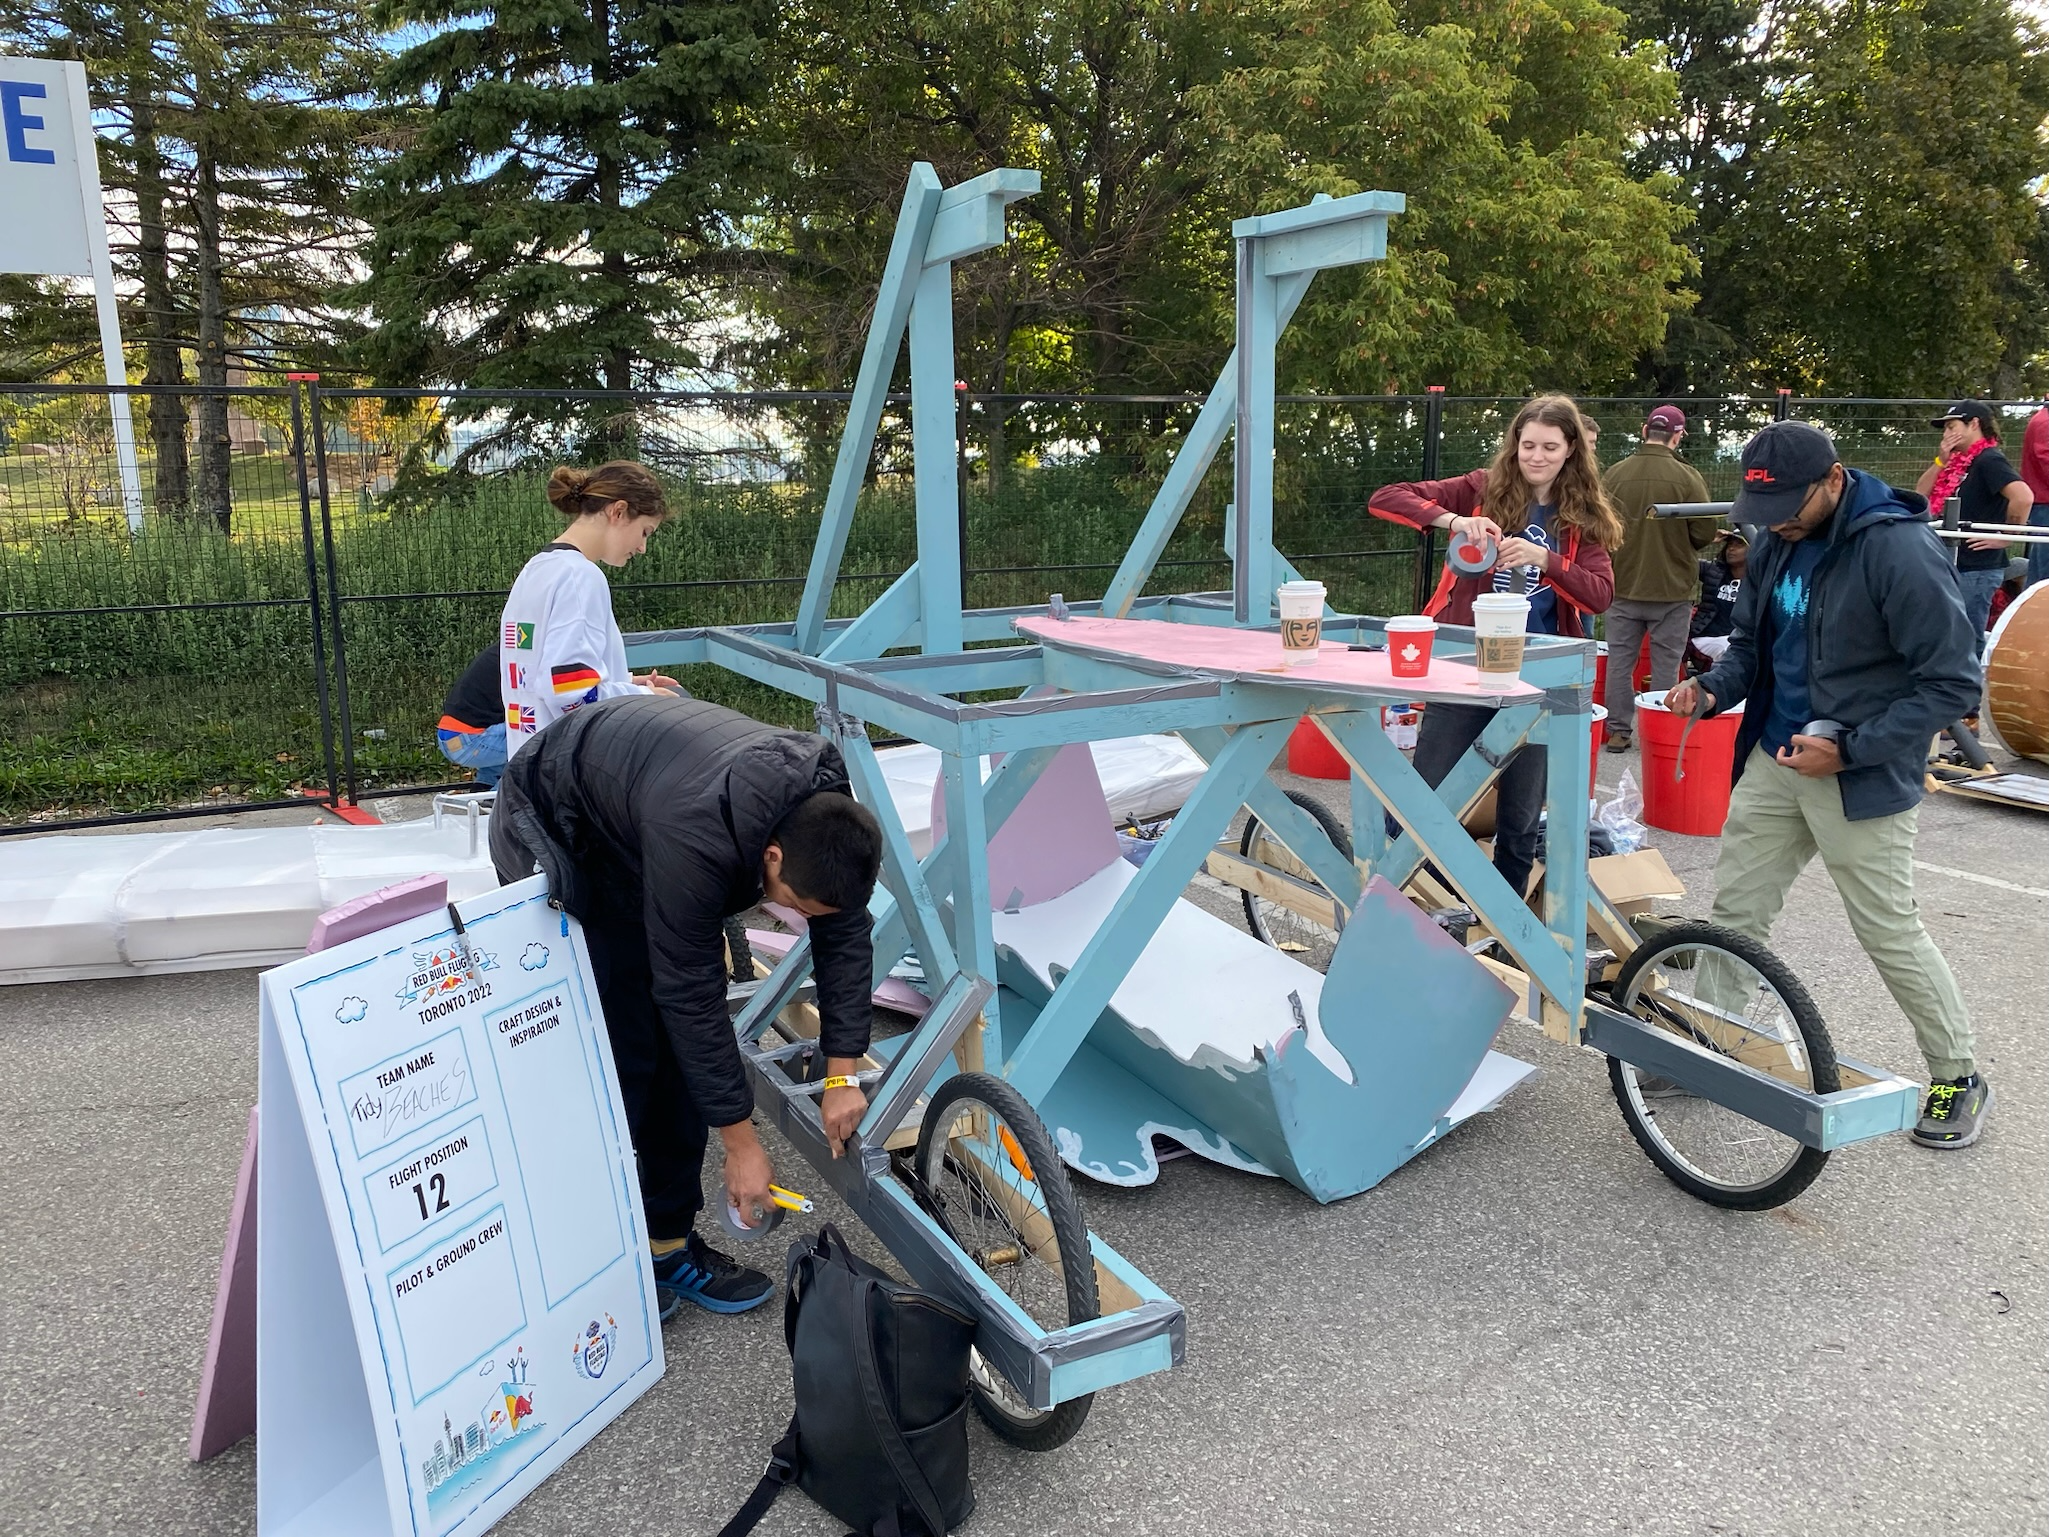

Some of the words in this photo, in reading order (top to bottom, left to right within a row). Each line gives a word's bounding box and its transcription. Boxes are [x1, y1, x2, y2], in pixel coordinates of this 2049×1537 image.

[0, 80, 55, 164] E
[1744, 469, 1775, 482] JPL
[413, 975, 429, 989] RED
[429, 967, 448, 982] BULL
[418, 994, 466, 1025] TORONTO
[467, 983, 492, 1004] 2022
[499, 1013, 524, 1033] CRAFT
[525, 998, 554, 1021] DESIGN
[555, 996, 562, 1007] &
[509, 1014, 560, 1048] INSPIRATION
[376, 1066, 405, 1088] TEAM
[406, 1052, 435, 1076] NAME
[350, 1092, 382, 1122] Tidy
[383, 1057, 466, 1138] BEACHES
[389, 1160, 422, 1189] FLIGHT
[424, 1136, 468, 1170] POSITION
[412, 1173, 450, 1221] 12
[396, 1269, 423, 1298] PILOT
[426, 1265, 434, 1278] &
[436, 1238, 476, 1271] GROUND
[478, 1220, 502, 1245] CREW
